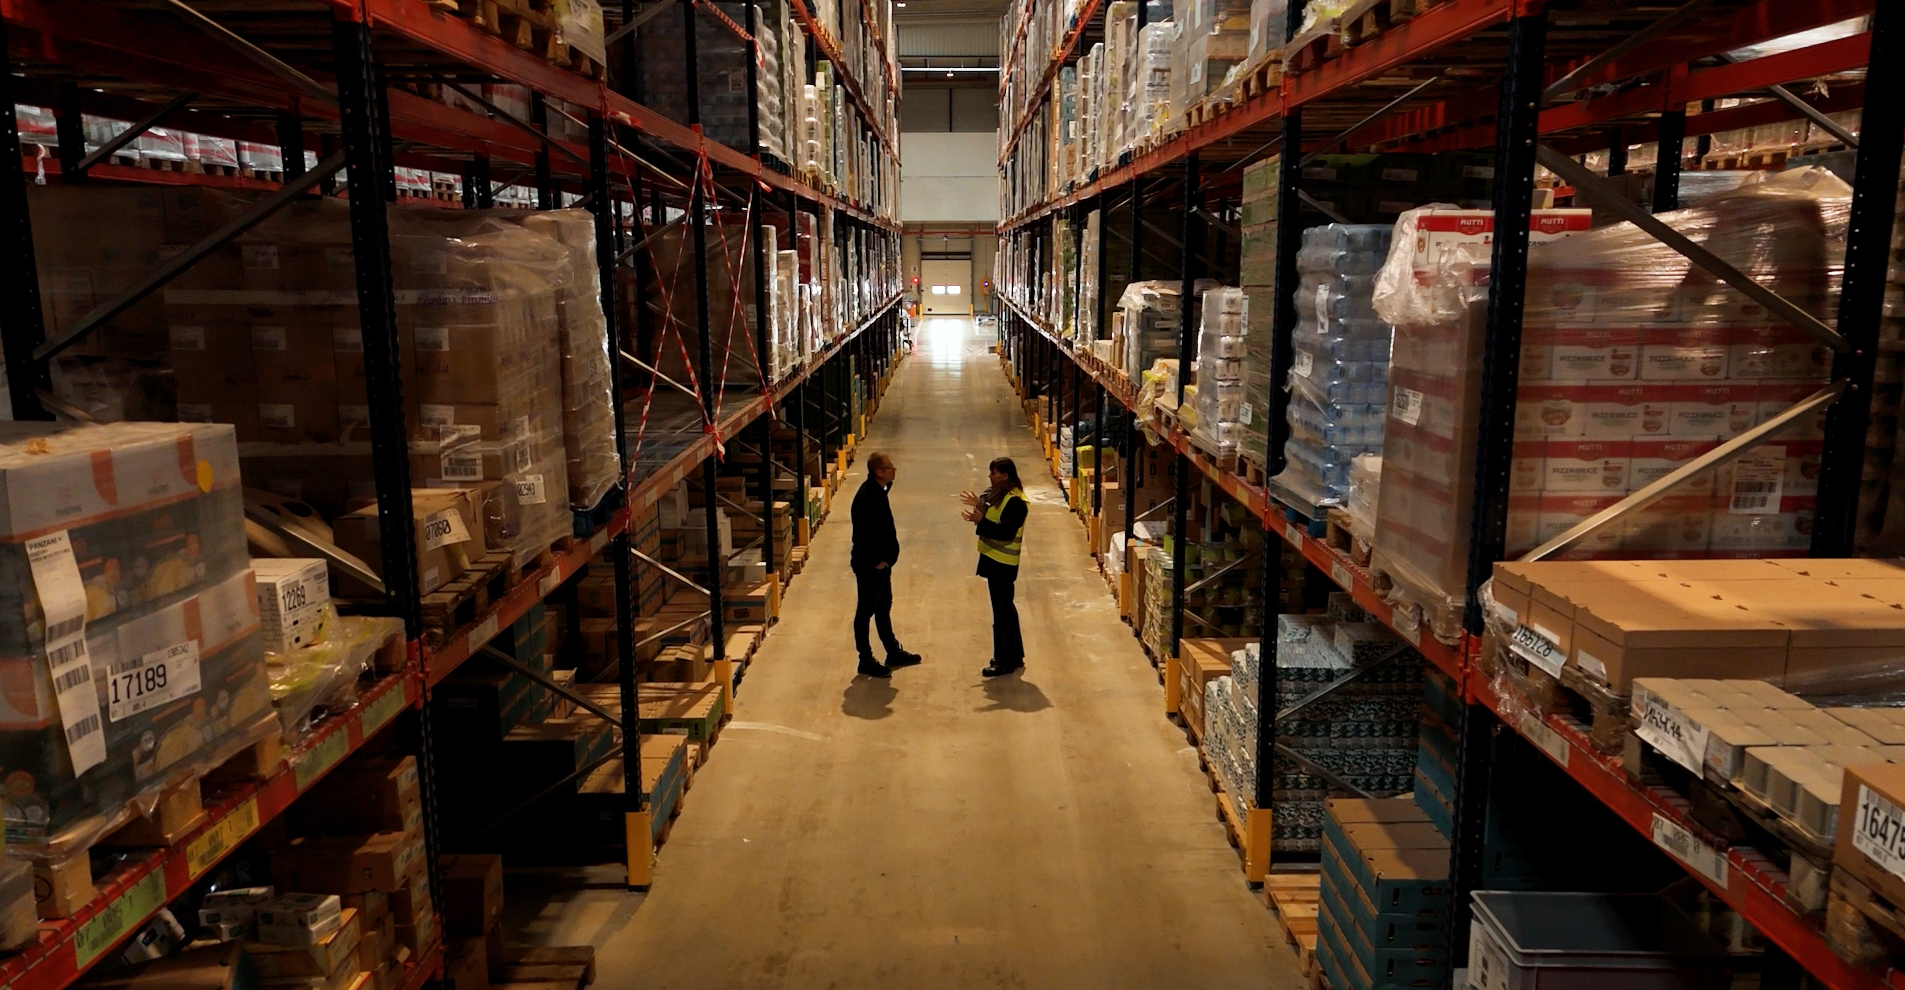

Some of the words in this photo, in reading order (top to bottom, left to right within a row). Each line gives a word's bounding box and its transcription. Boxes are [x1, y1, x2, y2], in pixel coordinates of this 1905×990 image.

[518, 482, 535, 497] 02943
[426, 519, 451, 540] 07060
[29, 538, 58, 551] PANZANI
[282, 585, 306, 612] 12269
[1514, 624, 1554, 657] 166128
[112, 664, 167, 704] 17189
[76, 927, 89, 949] 07
